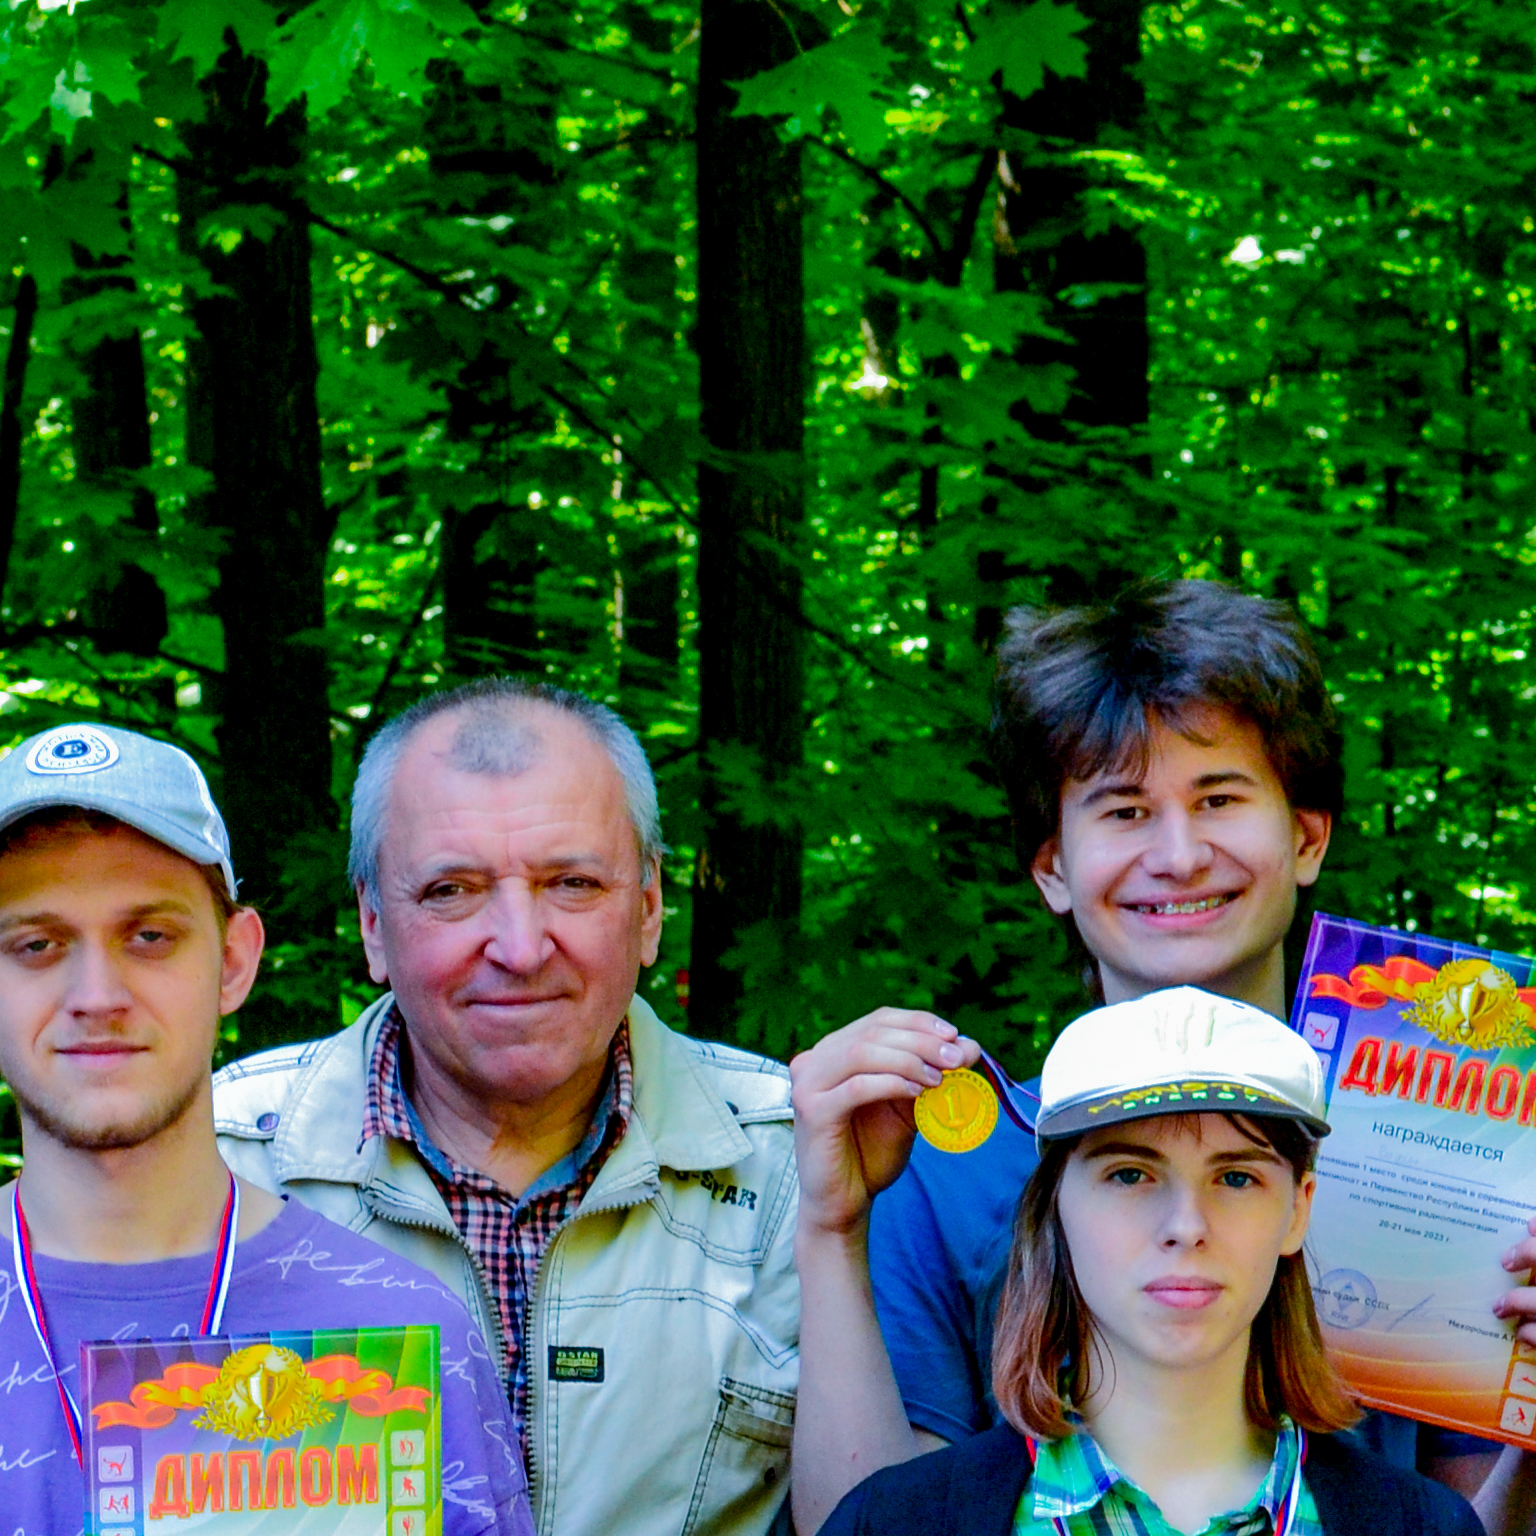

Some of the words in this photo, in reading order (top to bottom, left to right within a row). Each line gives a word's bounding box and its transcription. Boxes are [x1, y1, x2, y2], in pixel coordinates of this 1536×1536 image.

[1372, 1120, 1505, 1163] награждается
[1319, 1154, 1360, 1170] анявший
[1369, 1167, 1397, 1179] место
[1401, 1174, 1429, 1187] среди
[1317, 1170, 1360, 1184] емпионат
[1370, 1181, 1424, 1200] Первенство
[1426, 1194, 1480, 1213] Республики
[1348, 1192, 1361, 1201] по
[1362, 1195, 1418, 1215] спортивной
[1404, 1226, 1421, 1236] мая
[1423, 1230, 1444, 1243] 2023
[1448, 1318, 1500, 1339] Нехорошев
[149, 1442, 380, 1521] ДИПЛОМ
